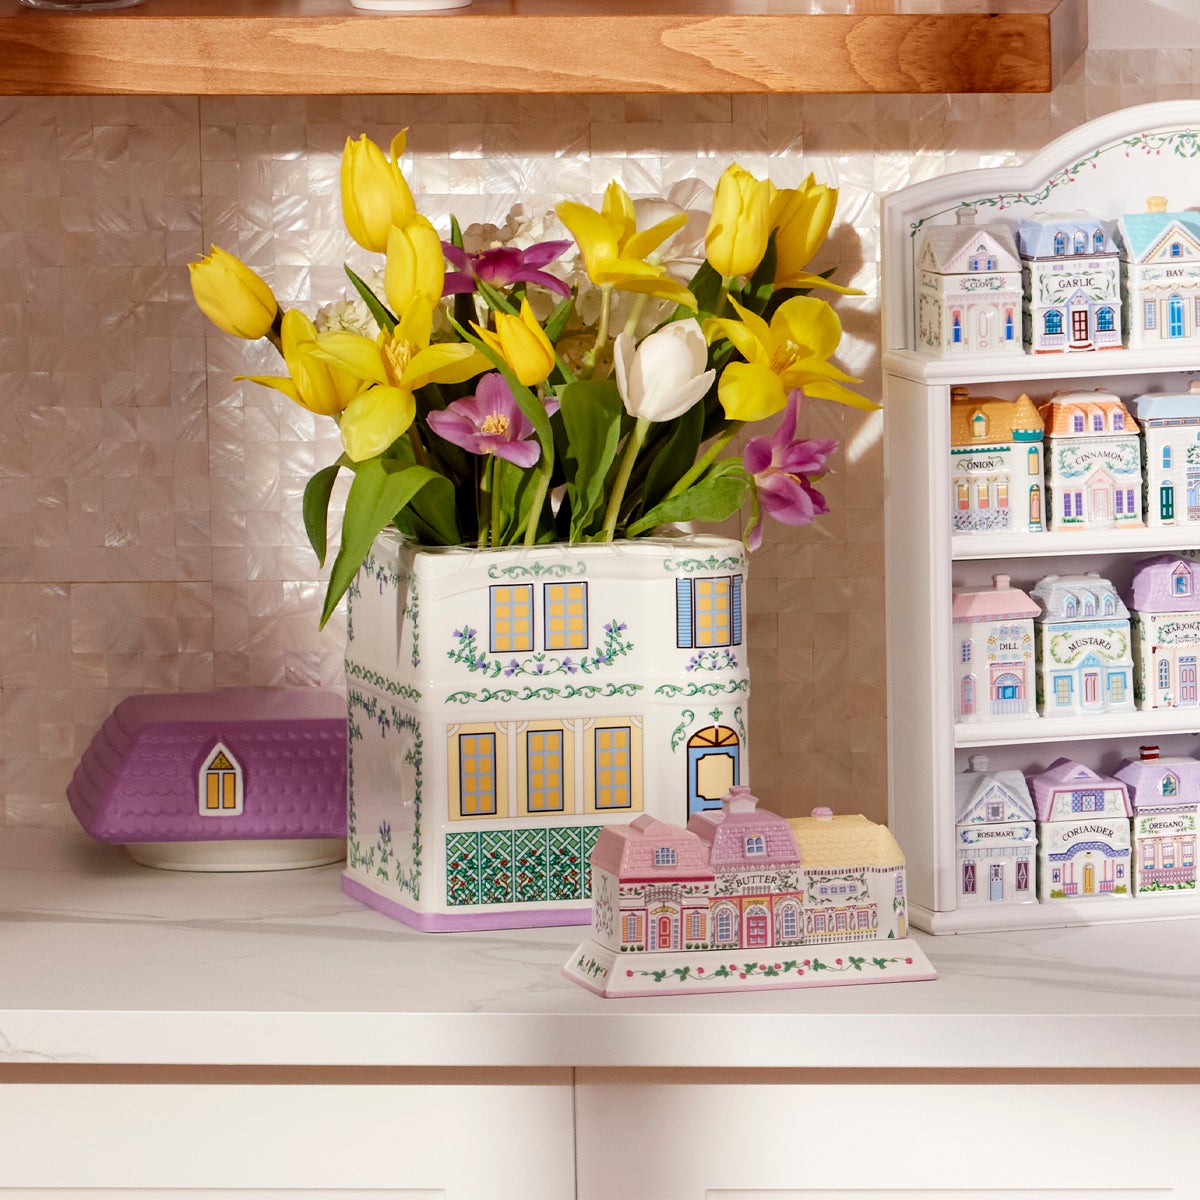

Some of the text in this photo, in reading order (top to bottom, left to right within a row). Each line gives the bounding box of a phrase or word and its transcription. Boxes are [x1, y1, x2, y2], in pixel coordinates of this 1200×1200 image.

[1166, 269, 1185, 278] BAY
[1058, 277, 1096, 289] GARLIC
[1075, 450, 1124, 465] CINNAMON
[966, 460, 994, 469] ONION
[999, 643, 1019, 651] DILL
[1068, 637, 1112, 652] MUSTARD
[1148, 820, 1184, 830] OREGANO
[977, 830, 1016, 839] ROSEMARY
[1062, 825, 1115, 842] CORIANDER
[735, 873, 778, 888] BUTTER
